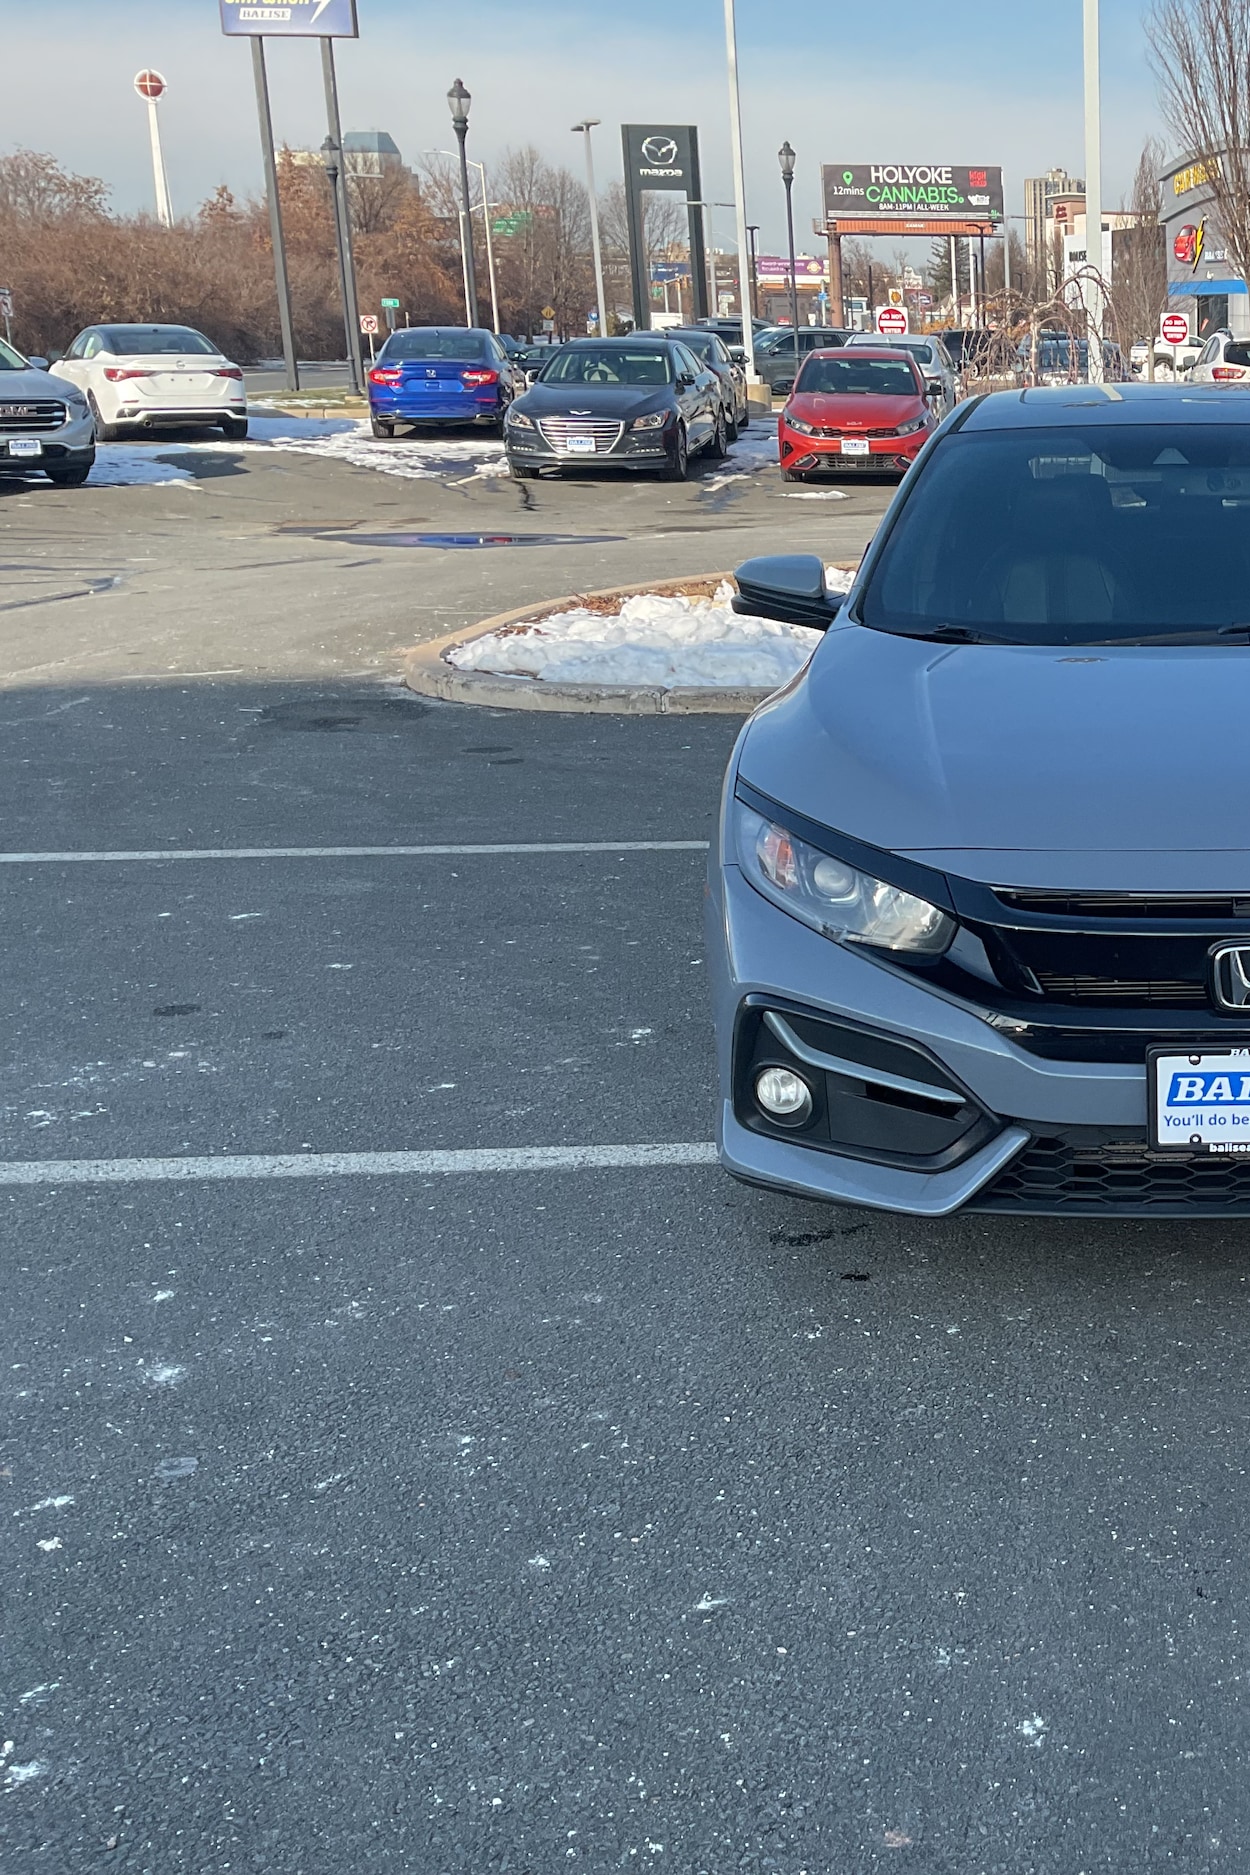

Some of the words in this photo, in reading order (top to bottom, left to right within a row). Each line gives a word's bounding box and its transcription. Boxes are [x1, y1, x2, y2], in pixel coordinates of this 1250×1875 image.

[242, 9, 289, 18] BALISE
[640, 168, 683, 177] mazda
[871, 166, 953, 184] HOLYOKE
[833, 186, 865, 196] 12mins
[879, 203, 913, 211] 8AM-11PM
[916, 203, 949, 211] ALL-WEEK
[1164, 1114, 1203, 1127] You'll
[1208, 1114, 1227, 1126] do
